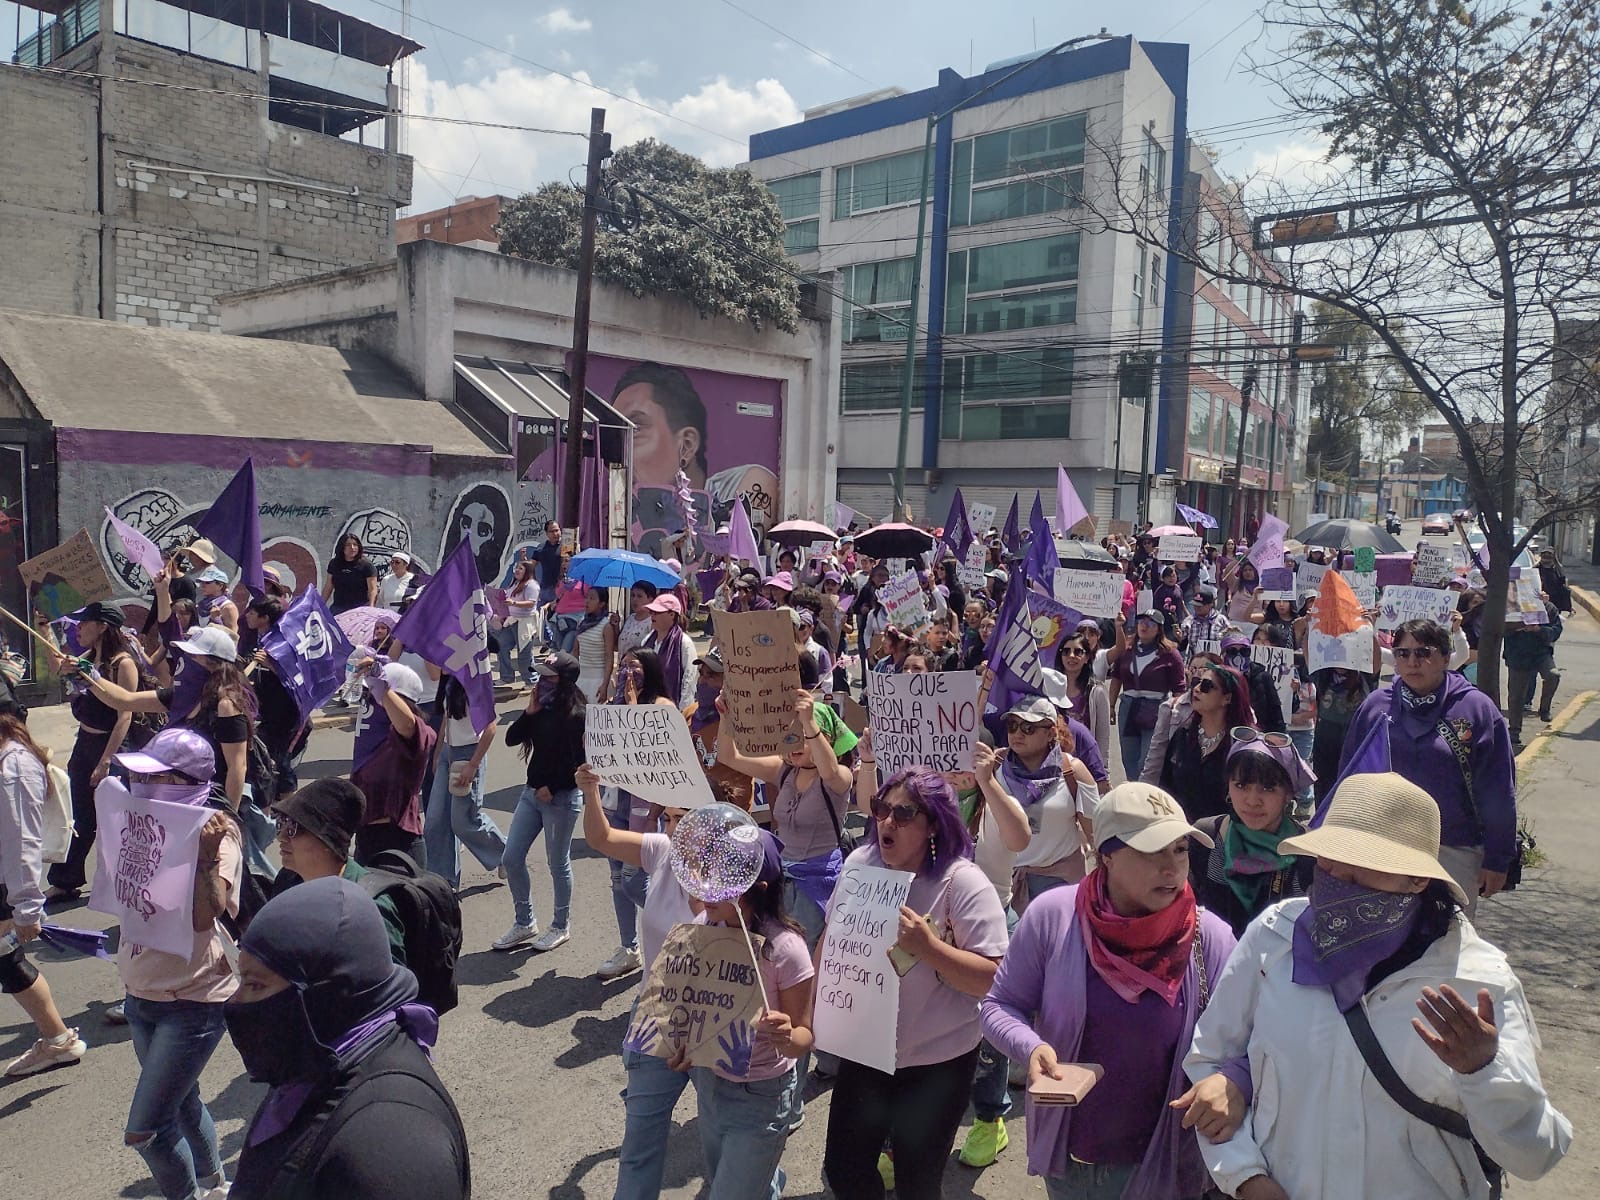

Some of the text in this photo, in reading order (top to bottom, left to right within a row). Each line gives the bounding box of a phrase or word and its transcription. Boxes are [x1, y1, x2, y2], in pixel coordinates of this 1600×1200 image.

[258, 502, 331, 519] ÓXIMAMENTE
[871, 671, 949, 697] LAS QUE
[870, 712, 920, 735] TUDIAR
[937, 701, 976, 734] NO
[871, 696, 923, 719] ERON A
[626, 707, 677, 732] COGER
[630, 731, 675, 750] DEVER
[875, 731, 969, 754] SARON PARA
[643, 770, 694, 790] MUJER
[838, 938, 872, 958] quiero
[824, 958, 871, 985] regresar
[682, 985, 735, 1010] QUEREMOS
